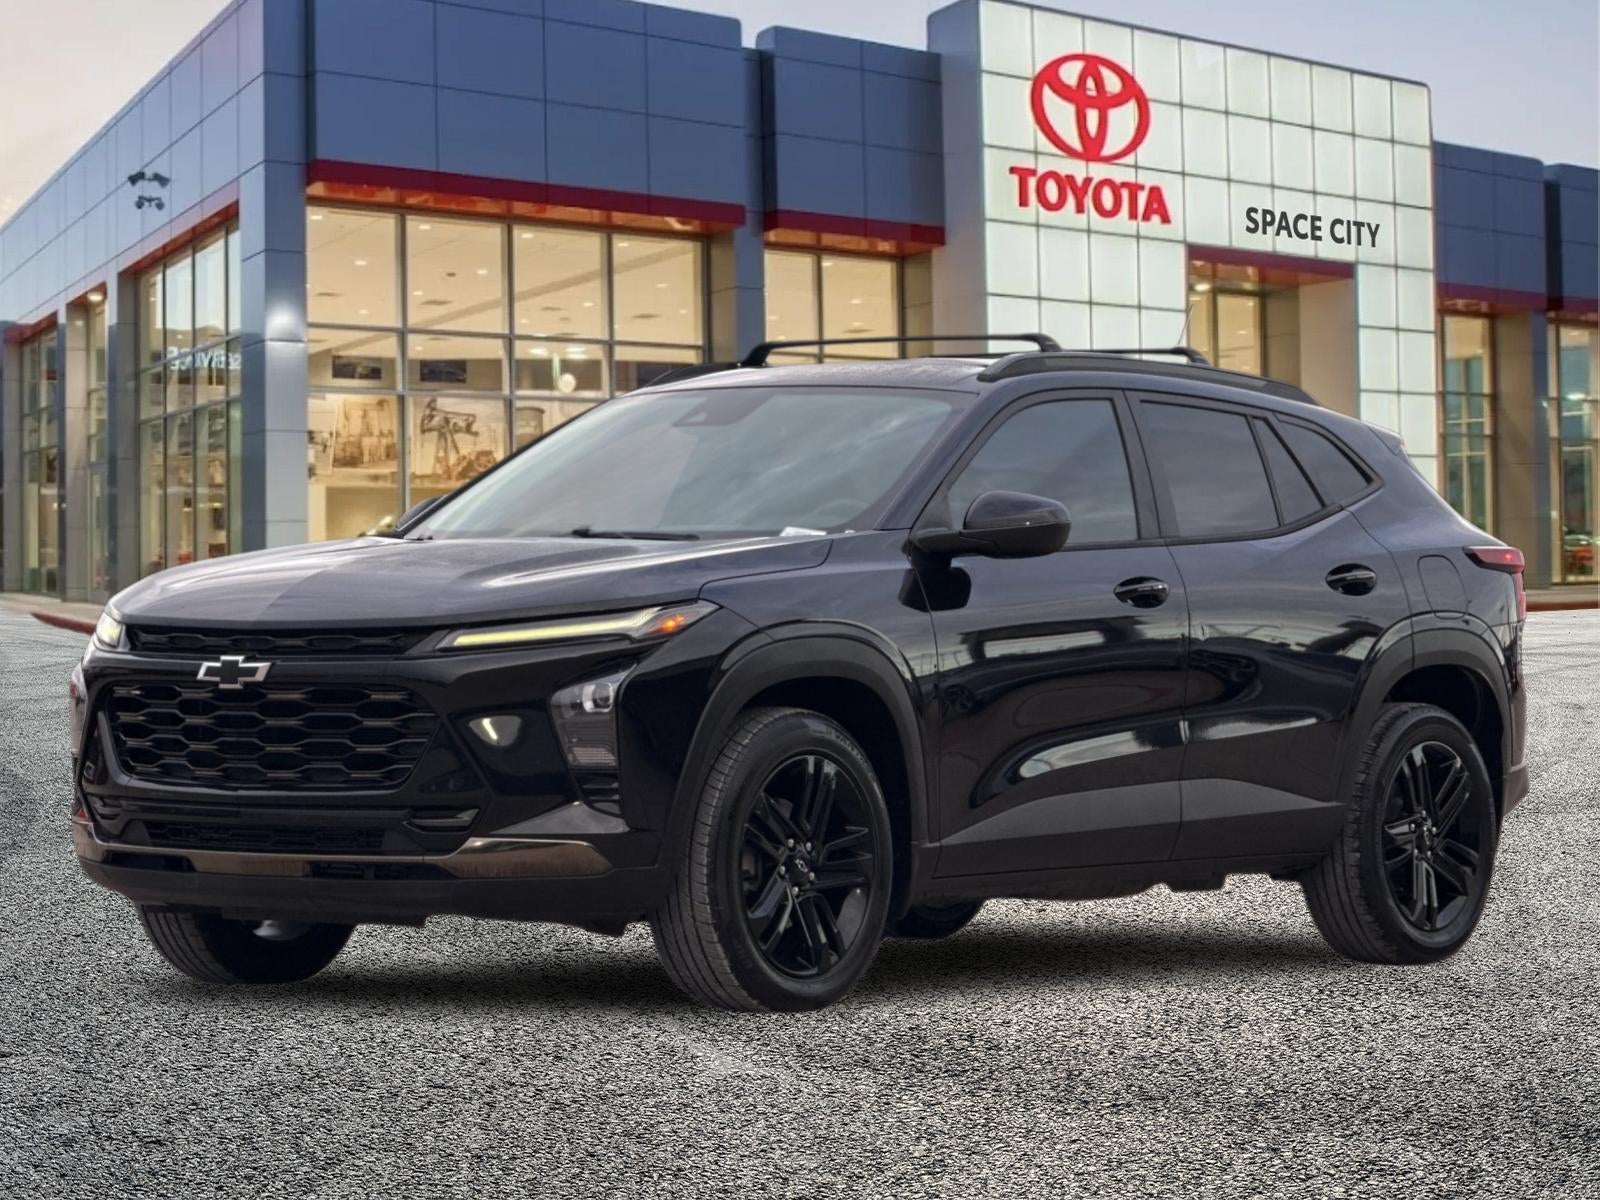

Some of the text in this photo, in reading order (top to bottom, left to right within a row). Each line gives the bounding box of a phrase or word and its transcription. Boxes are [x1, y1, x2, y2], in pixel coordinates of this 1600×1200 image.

[1009, 166, 1171, 225] TOYOTA
[1245, 206, 1381, 248] SPACE CITY
